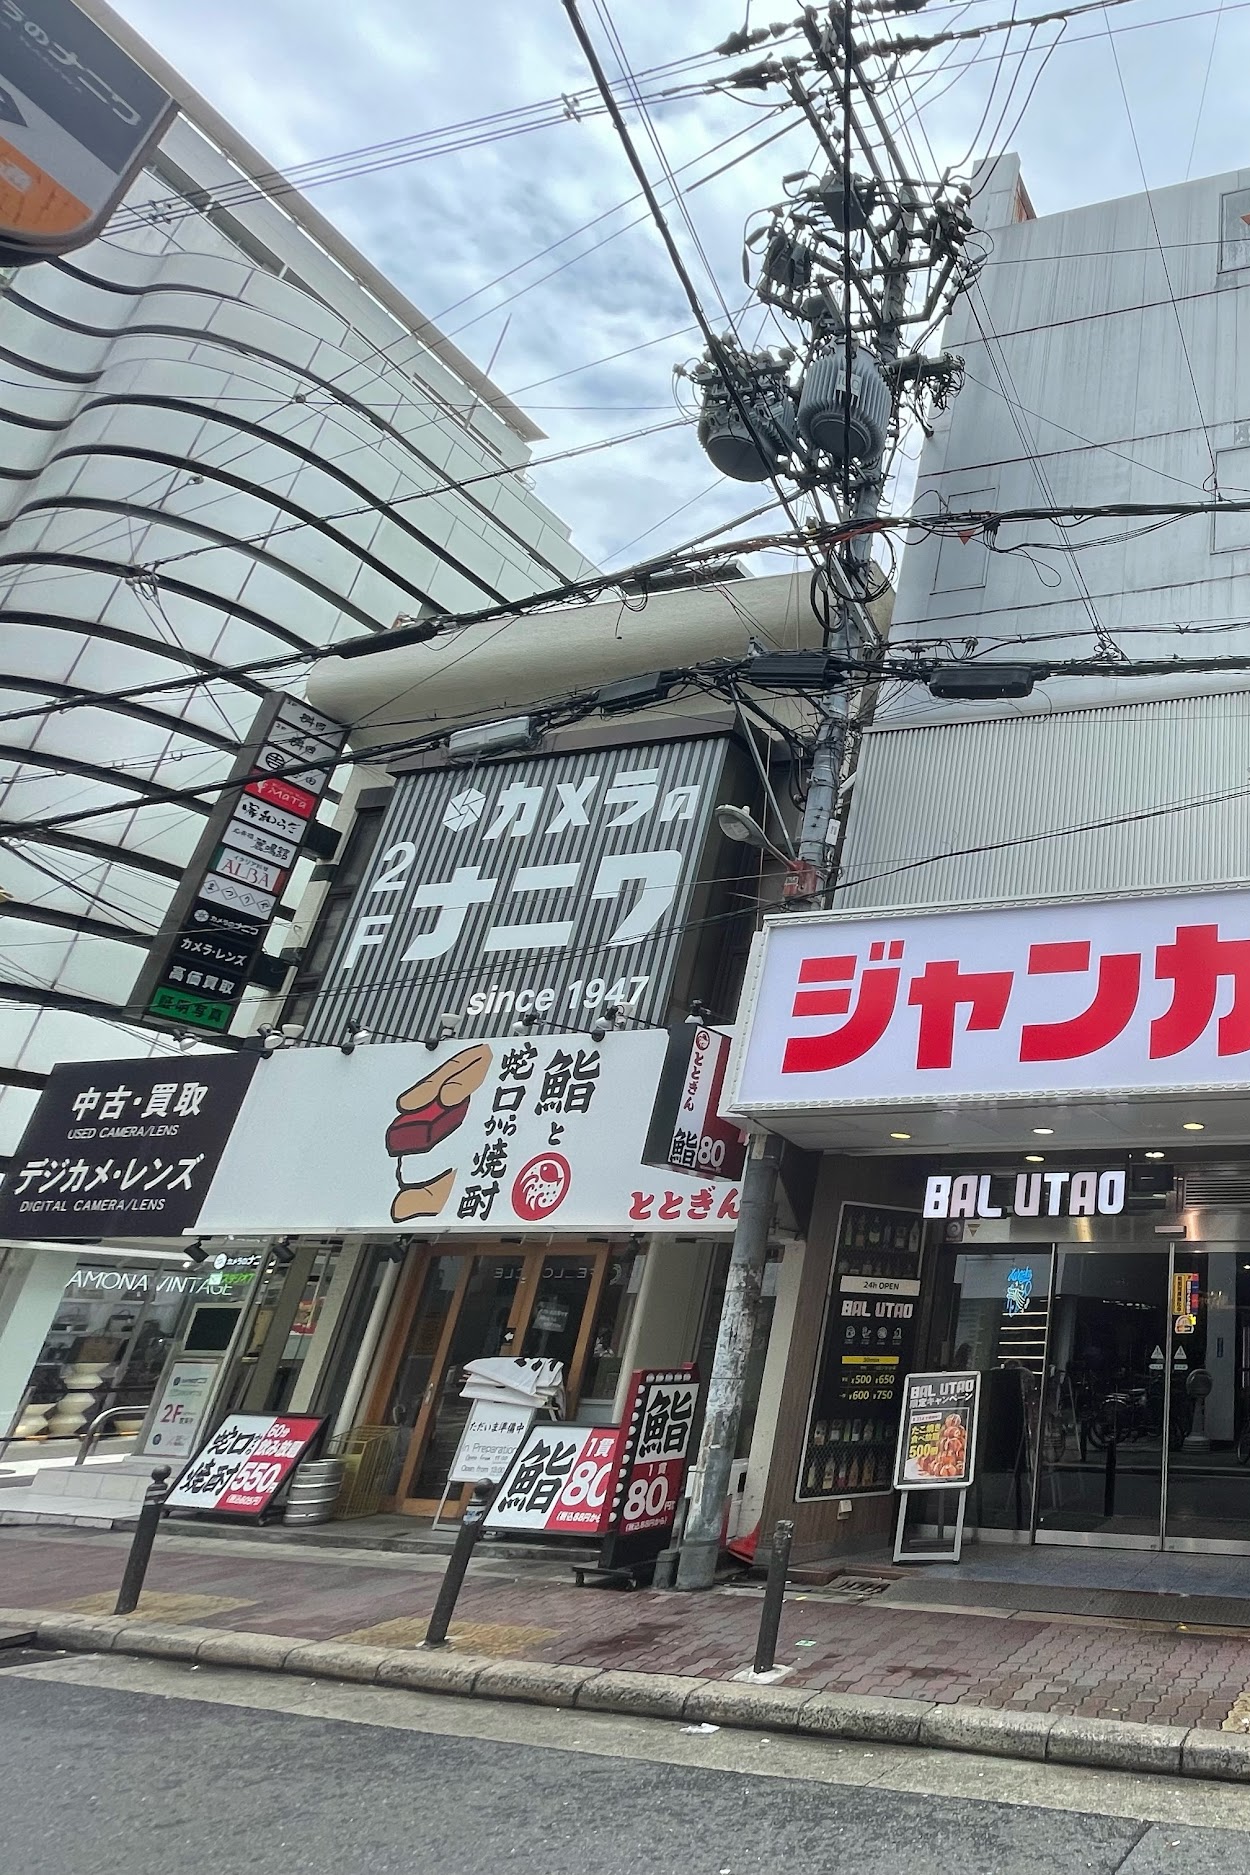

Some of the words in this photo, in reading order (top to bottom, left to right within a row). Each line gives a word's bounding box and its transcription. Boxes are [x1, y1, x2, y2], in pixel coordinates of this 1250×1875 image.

[482, 768, 701, 840] カメラの
[221, 858, 269, 888] ALBA
[401, 850, 683, 962] ナニワ
[180, 937, 248, 966] カメラ・レンズ
[169, 965, 236, 995] 高価買取
[466, 983, 556, 1017] since
[568, 976, 650, 1012] 1947
[72, 1081, 209, 1122] 中古・買取
[68, 1127, 96, 1140] USED
[99, 1124, 180, 1138] CAMERA/LENS
[670, 1127, 698, 1167] 鮨
[698, 1135, 726, 1168] 80
[14, 1153, 206, 1196] デジカメ・レンズ
[19, 1200, 68, 1212] DIGITAL
[73, 1198, 166, 1211] CAMERA/LENS
[922, 1174, 1002, 1219] BAL
[1014, 1170, 1127, 1217] UTAO
[879, 1282, 900, 1290] OPEN
[841, 1300, 871, 1317] BAL
[875, 1302, 914, 1318] UTAO
[911, 1384, 936, 1399] BAL
[940, 1380, 974, 1396] UTAO
[160, 1404, 184, 1423] 2F
[639, 1390, 695, 1458] 鮨
[180, 1458, 242, 1496] 焼酎
[498, 1439, 577, 1514] 鮨
